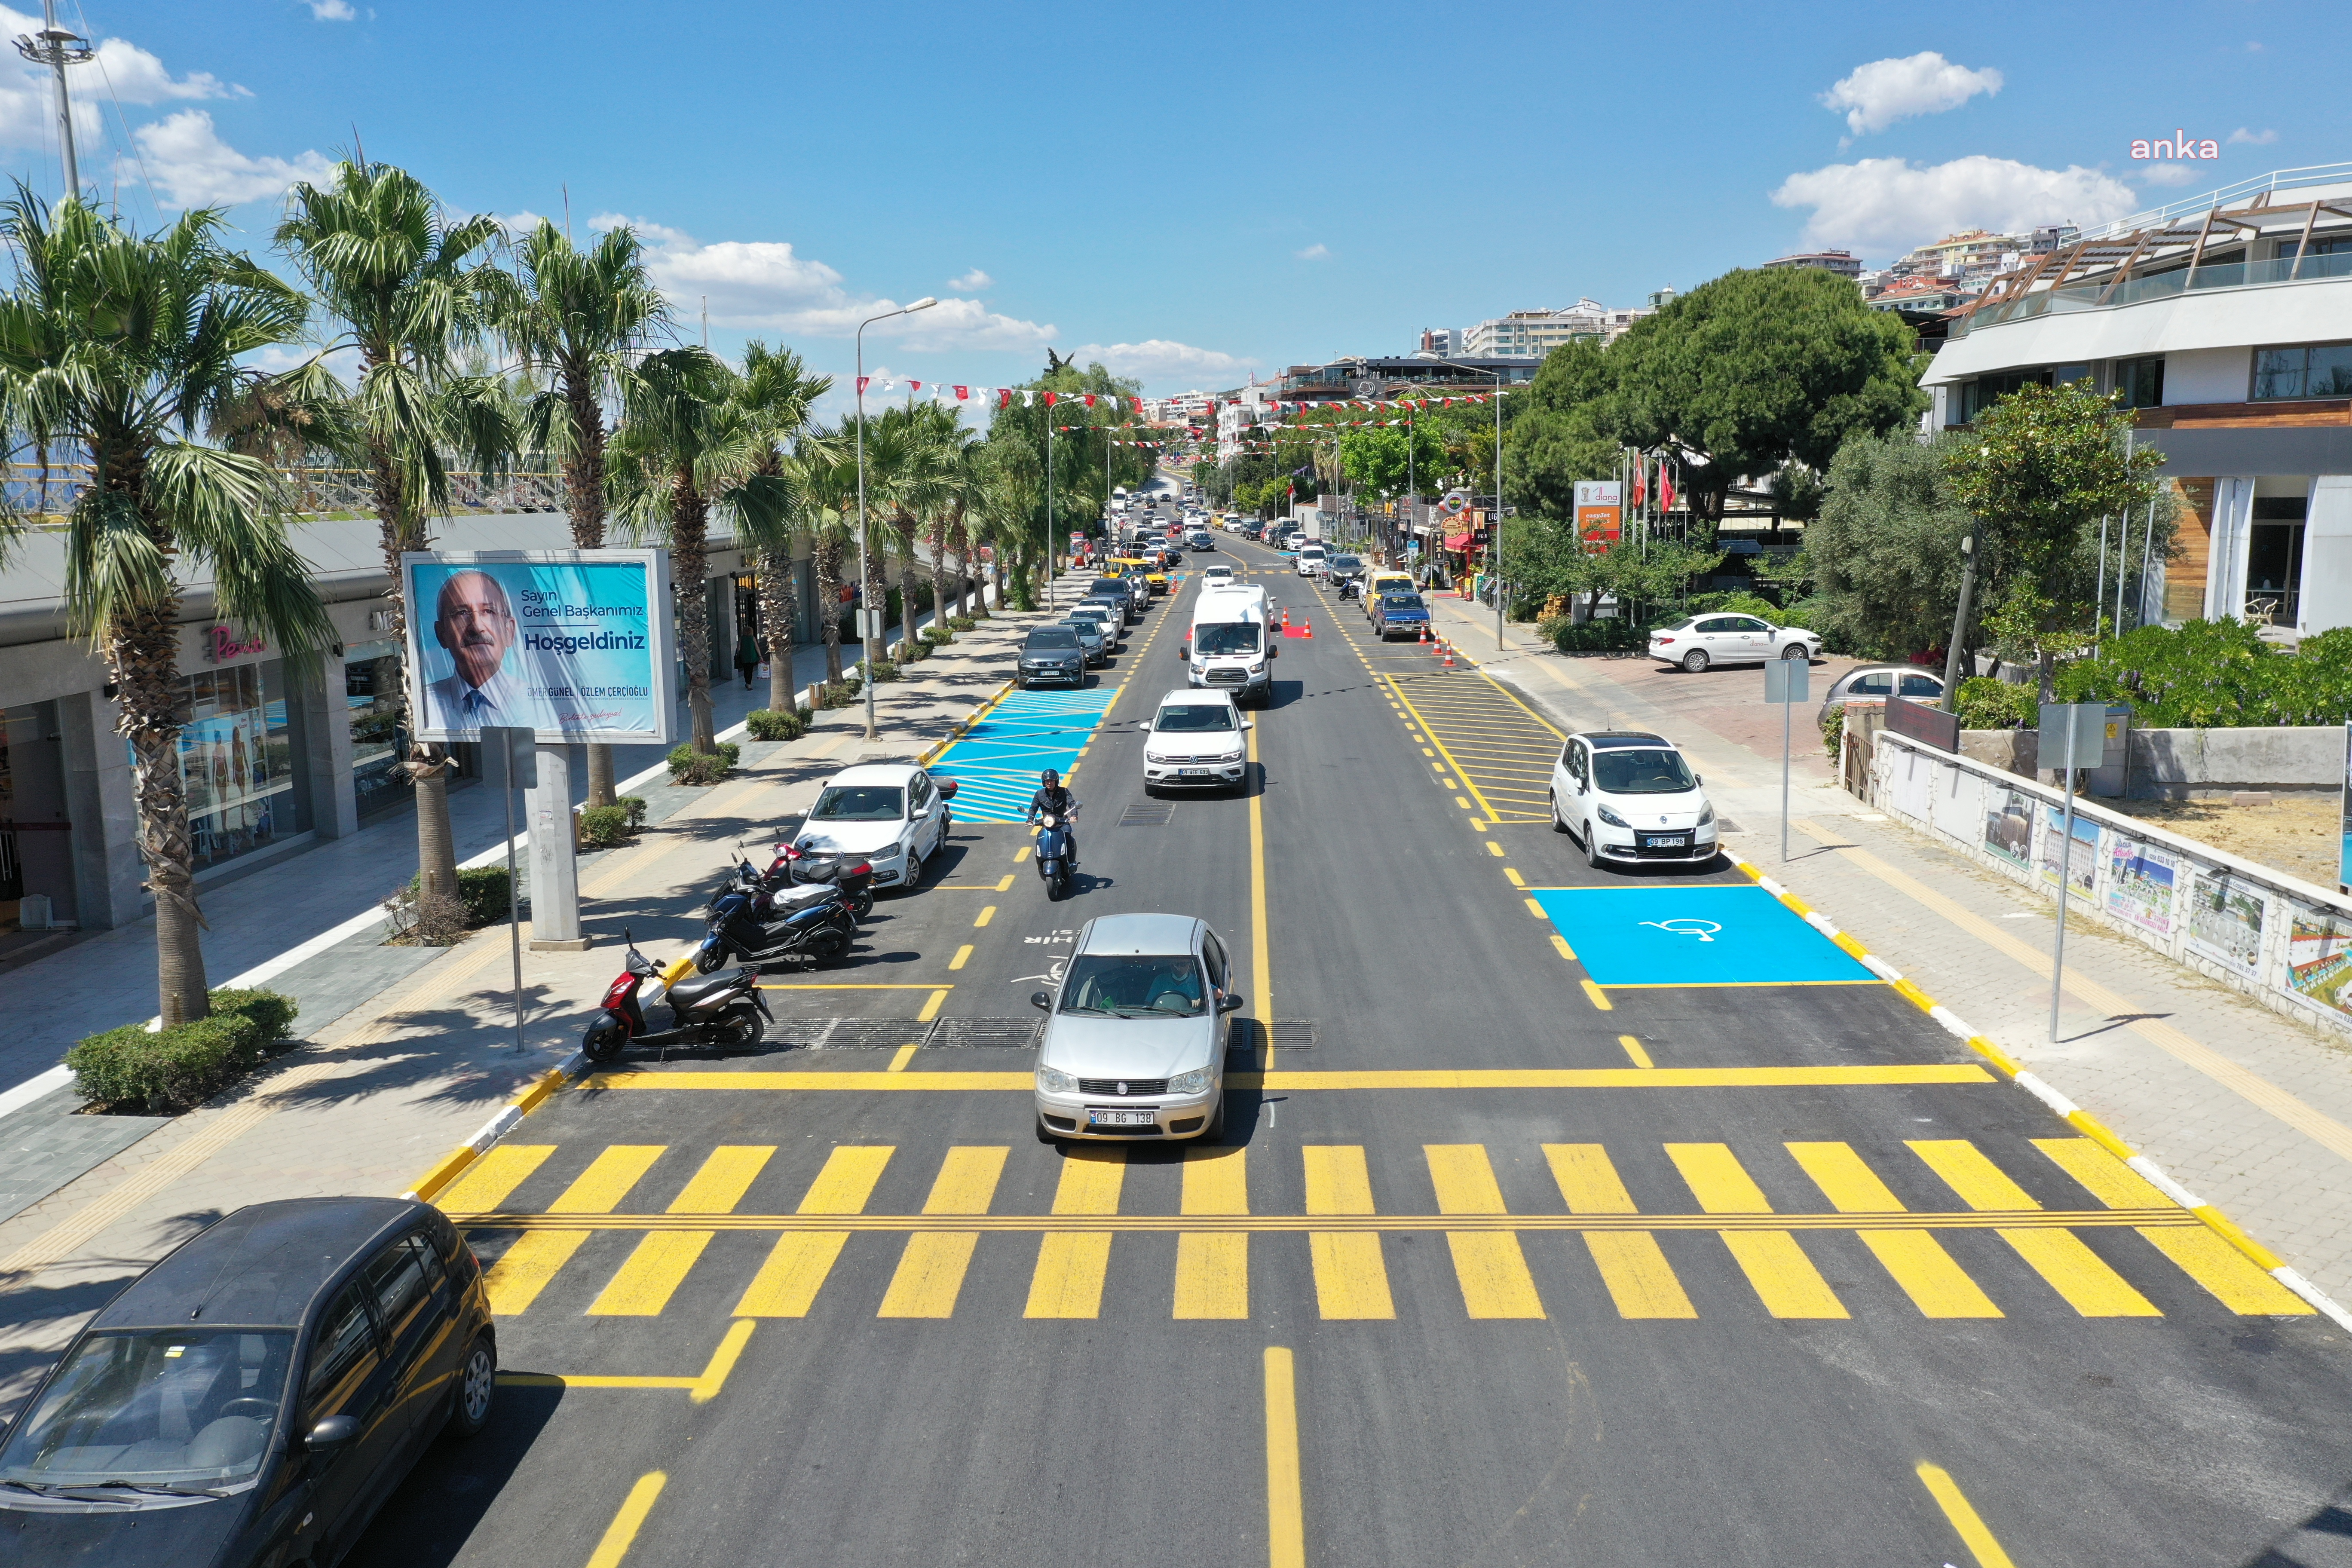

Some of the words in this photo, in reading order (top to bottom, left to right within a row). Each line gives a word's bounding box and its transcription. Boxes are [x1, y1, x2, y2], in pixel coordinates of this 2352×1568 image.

[1595, 486, 1617, 501] diana
[1441, 517, 1452, 529] HONG
[1452, 517, 1461, 529] KONG
[521, 589, 557, 604] Sayın
[522, 604, 561, 617] Genel
[565, 603, 643, 620] Başkanımız
[524, 630, 645, 655] Hoşgeldiniz
[548, 687, 574, 697] GÜNEL
[581, 685, 605, 696] ÖZLEM
[607, 685, 648, 697] ÇERÇİOĞLU
[1097, 1112, 1108, 1122] 09
[1115, 1113, 1126, 1123] BG
[1135, 1113, 1151, 1123] 138
